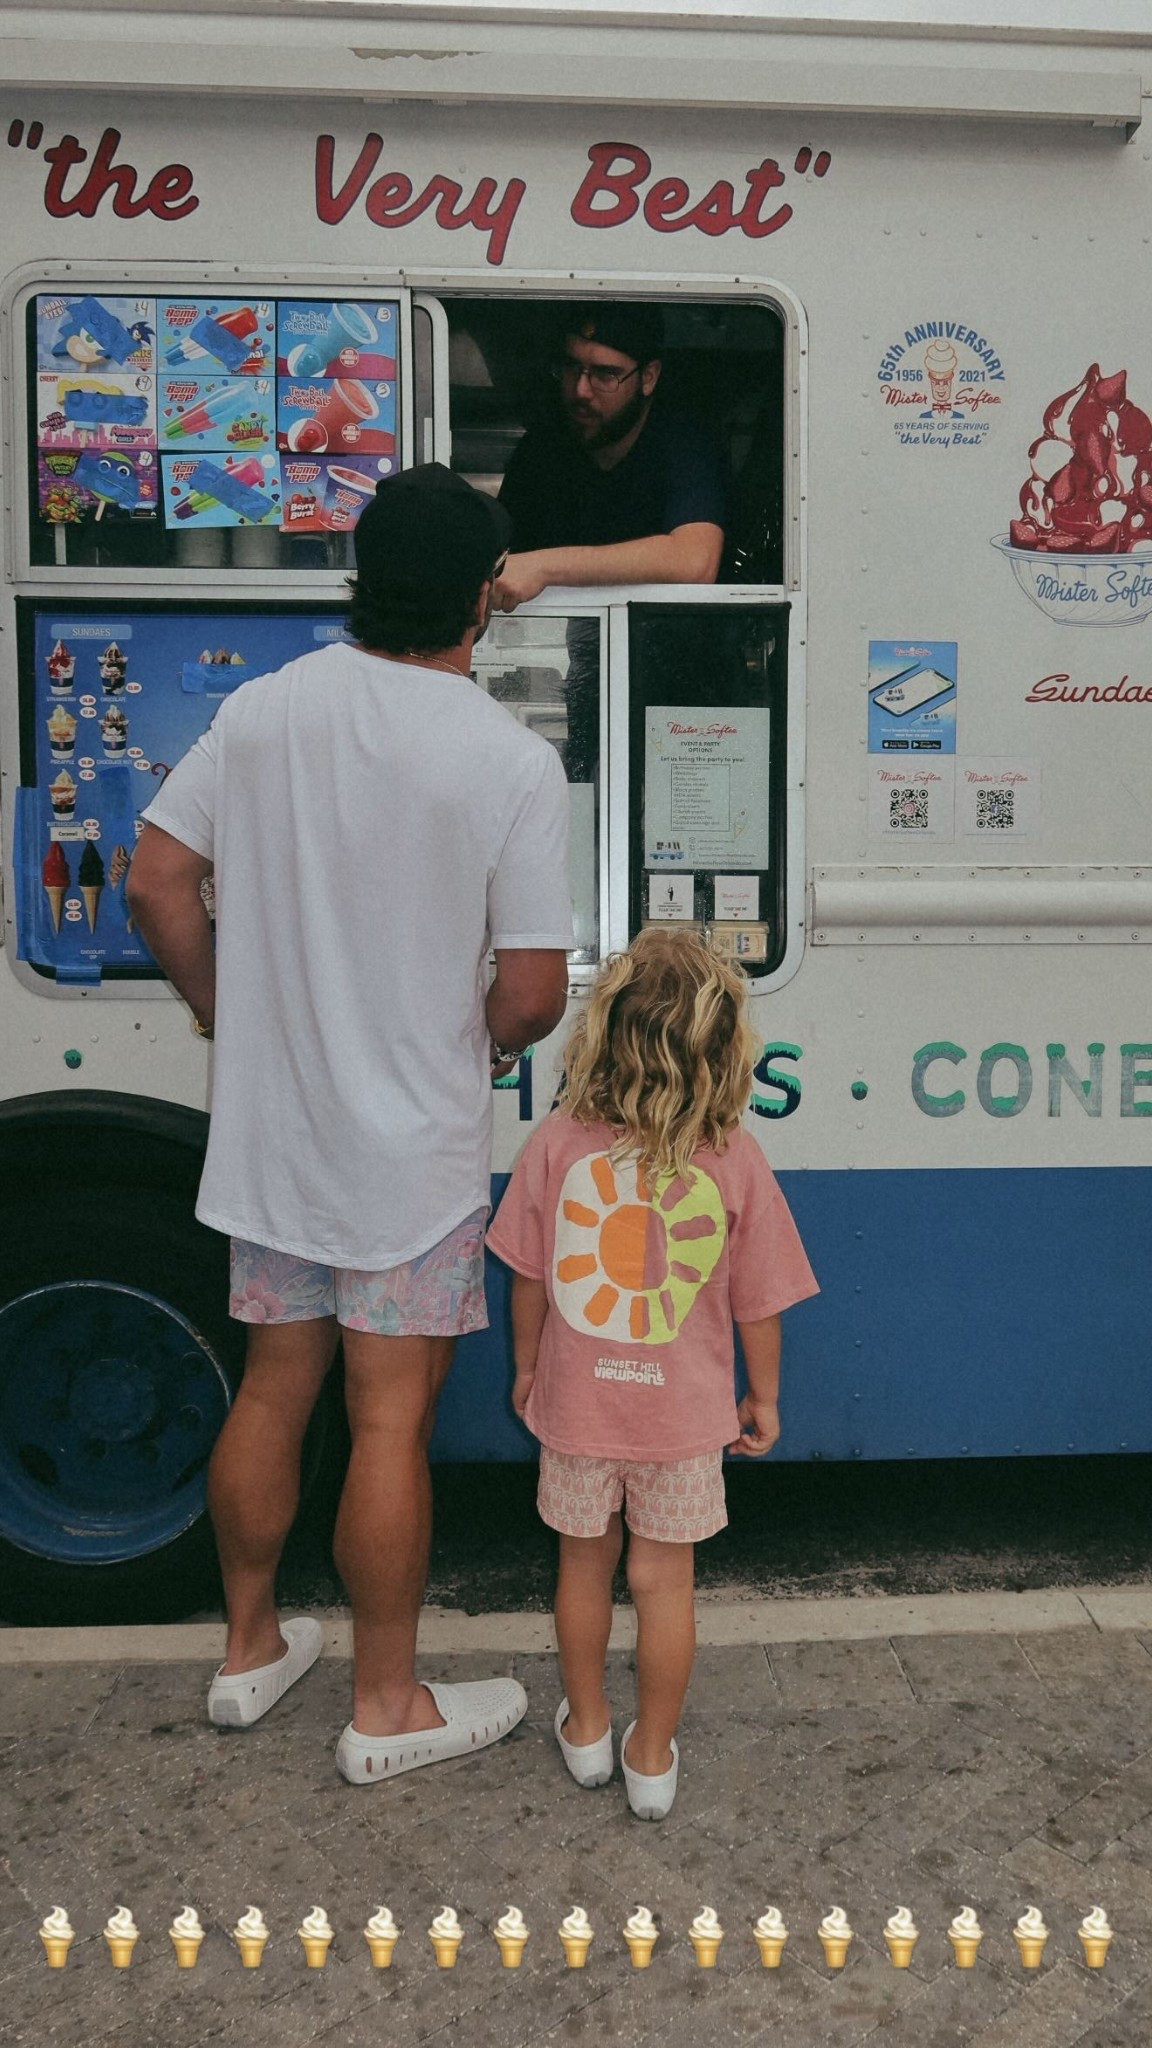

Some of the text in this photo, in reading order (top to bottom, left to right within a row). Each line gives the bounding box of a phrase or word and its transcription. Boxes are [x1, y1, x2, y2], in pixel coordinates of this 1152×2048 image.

[8, 119, 832, 265] "the Very Best"
[166, 308, 199, 318] BOMB
[168, 317, 194, 326] POP
[877, 321, 1006, 382] 65th ANNIVERSARY
[895, 370, 986, 382] 1956 2021
[167, 385, 199, 394] BOMB
[169, 393, 194, 402] POP
[880, 384, 1001, 412] Mister Softee
[894, 422, 990, 431] 65 YEARS OF SERVING
[922, 432, 950, 448] Very
[288, 465, 321, 474] BOMB
[291, 474, 316, 483] POP
[1036, 573, 1098, 602] Mister
[72, 627, 111, 637] SUNDAES
[667, 721, 698, 736] Mister
[877, 769, 906, 783] Mister
[964, 770, 993, 784] Mister
[911, 1041, 1152, 1118] CONE
[597, 1358, 662, 1373] SUNSET HILL
